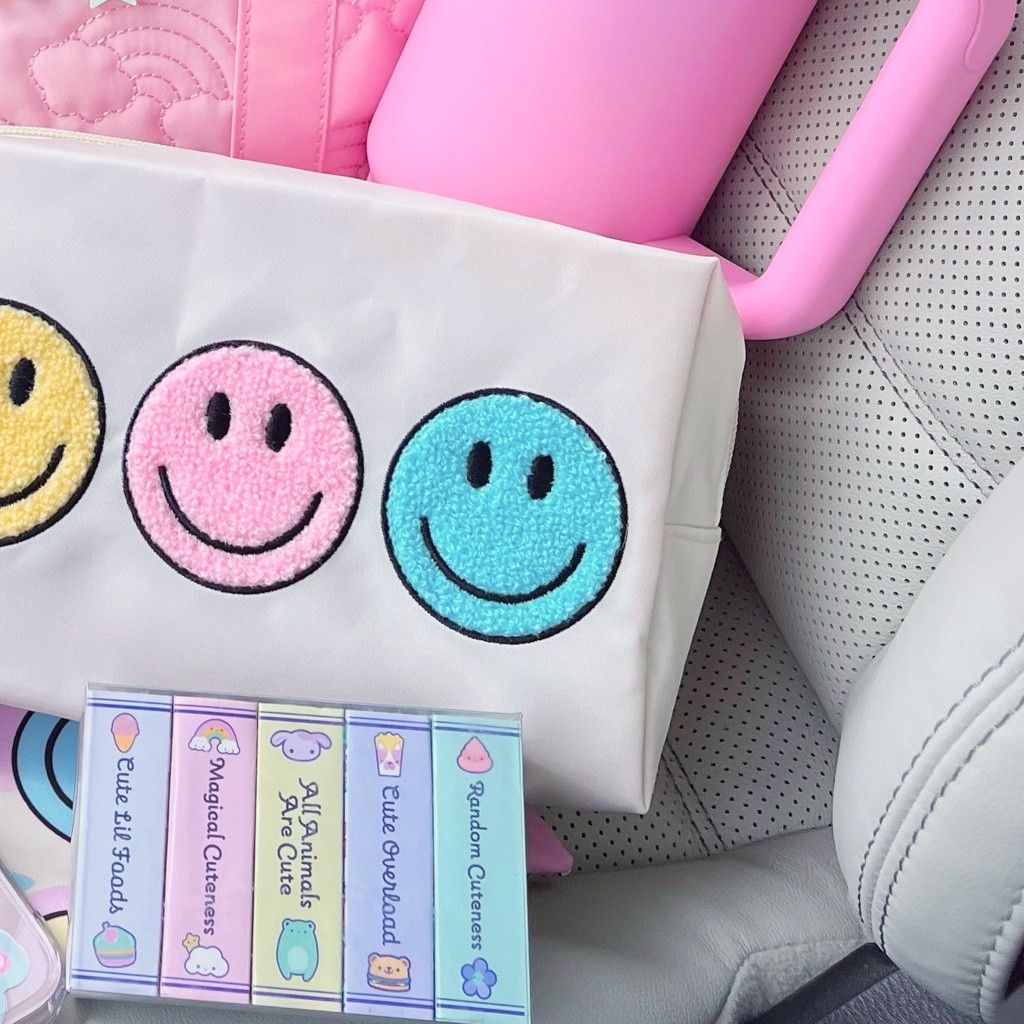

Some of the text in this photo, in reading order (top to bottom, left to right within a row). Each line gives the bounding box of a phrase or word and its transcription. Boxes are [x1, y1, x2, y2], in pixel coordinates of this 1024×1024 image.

[109, 756, 134, 915] Cute Lil Foods
[203, 757, 225, 936] Magical Cuteness
[277, 791, 299, 896] Are Cute
[298, 777, 322, 909] All Animals
[382, 784, 401, 946] Cute Overload
[466, 780, 487, 951] Random Cuteness
